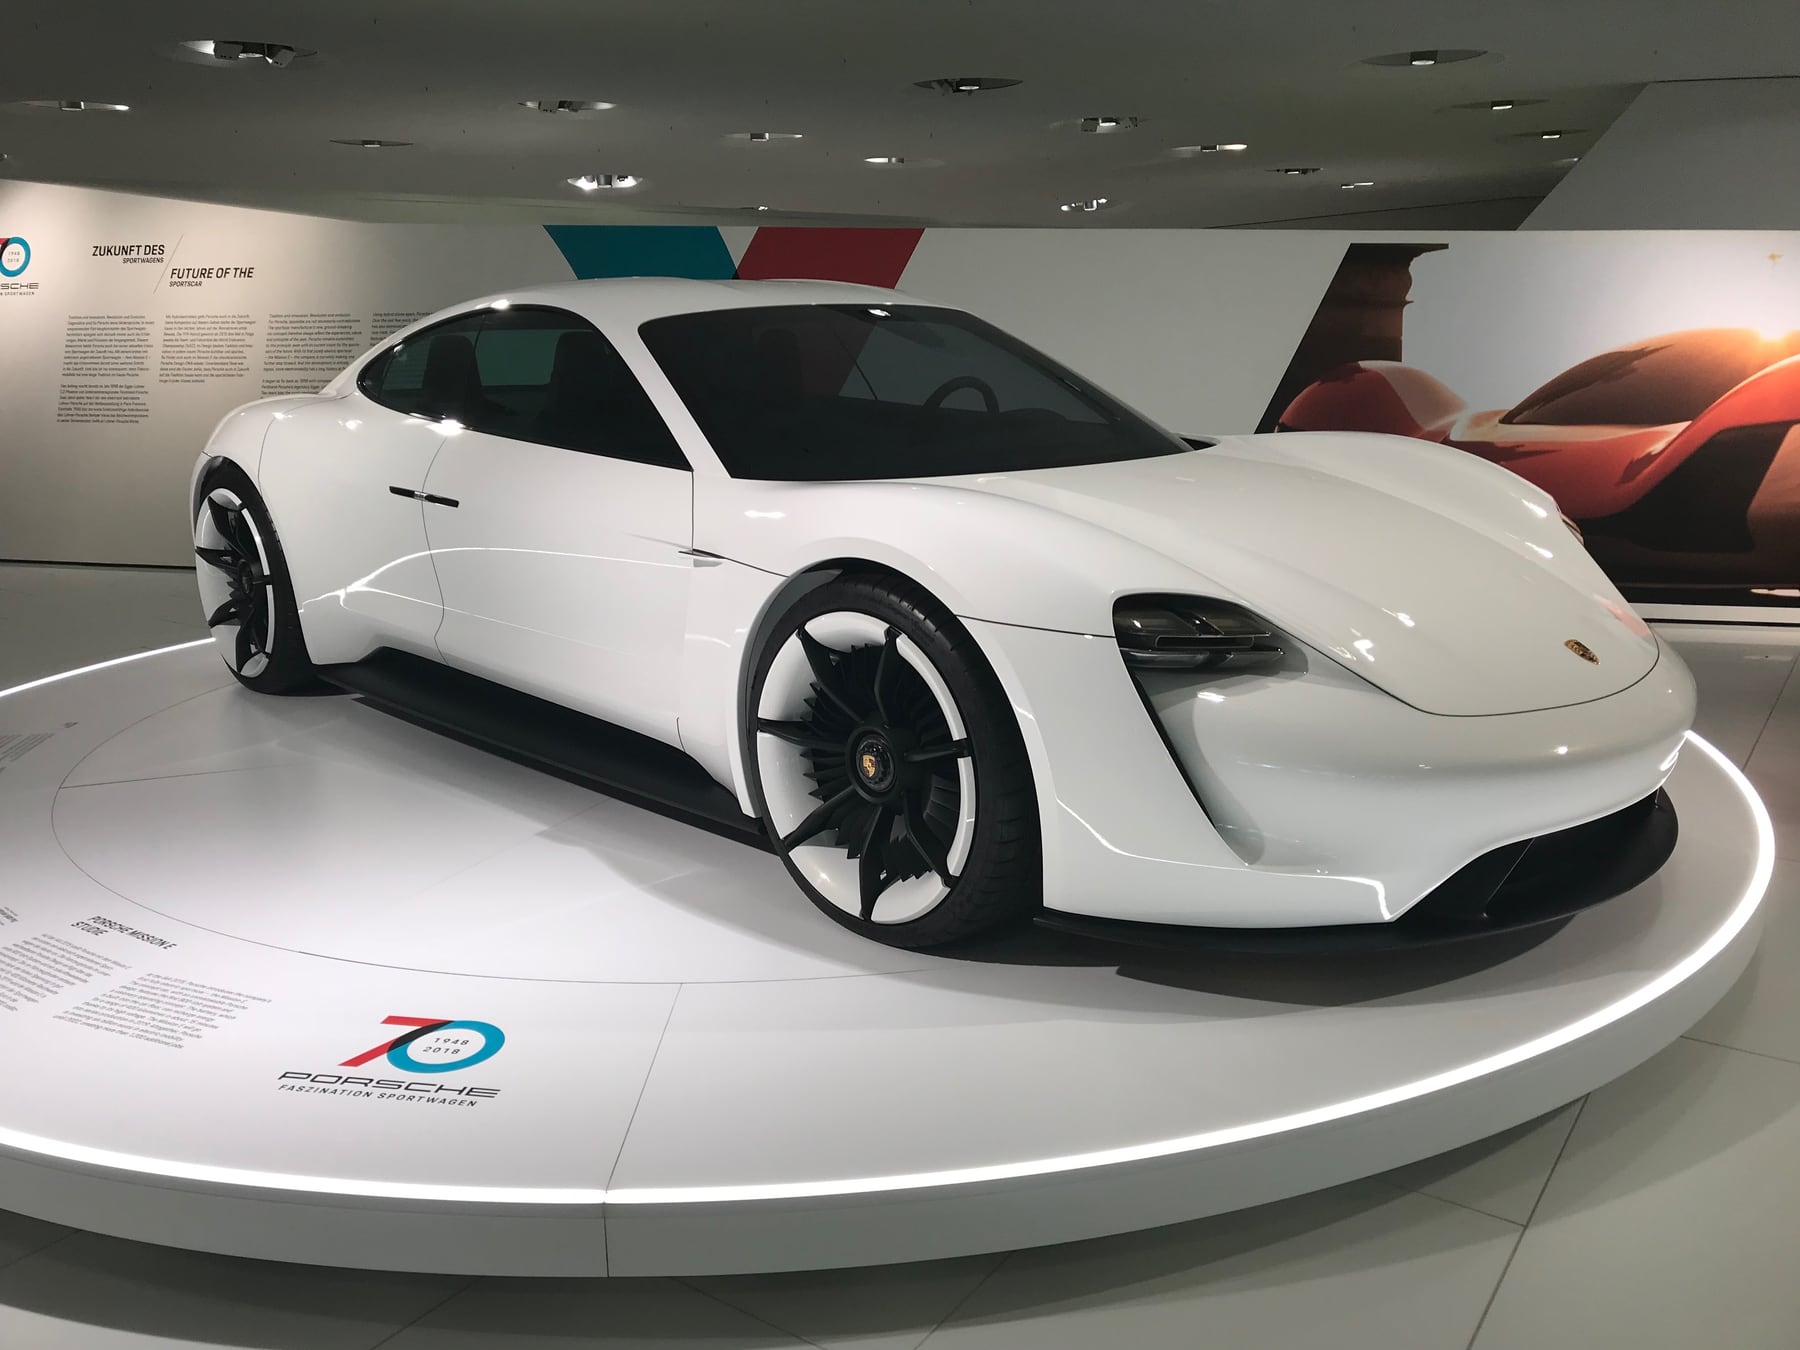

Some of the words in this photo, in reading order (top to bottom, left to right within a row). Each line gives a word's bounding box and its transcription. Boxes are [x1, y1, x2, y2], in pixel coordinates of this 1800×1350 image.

[92, 245, 142, 257] ZUKUNFT
[143, 244, 165, 256] DES
[170, 268, 213, 279] FUTURE
[215, 267, 231, 279] OF
[232, 267, 254, 279] THE
[70, 921, 109, 936] STUDIE
[88, 915, 133, 934] PORSCHE
[127, 929, 171, 948] MISSION
[338, 1015, 506, 1074] 70
[434, 1037, 470, 1046] 1948
[422, 1046, 461, 1055] 2018
[278, 1071, 501, 1099] PORSCHE
[278, 1084, 373, 1098] FASZINATION
[377, 1092, 478, 1107] SPORTWAGEN
